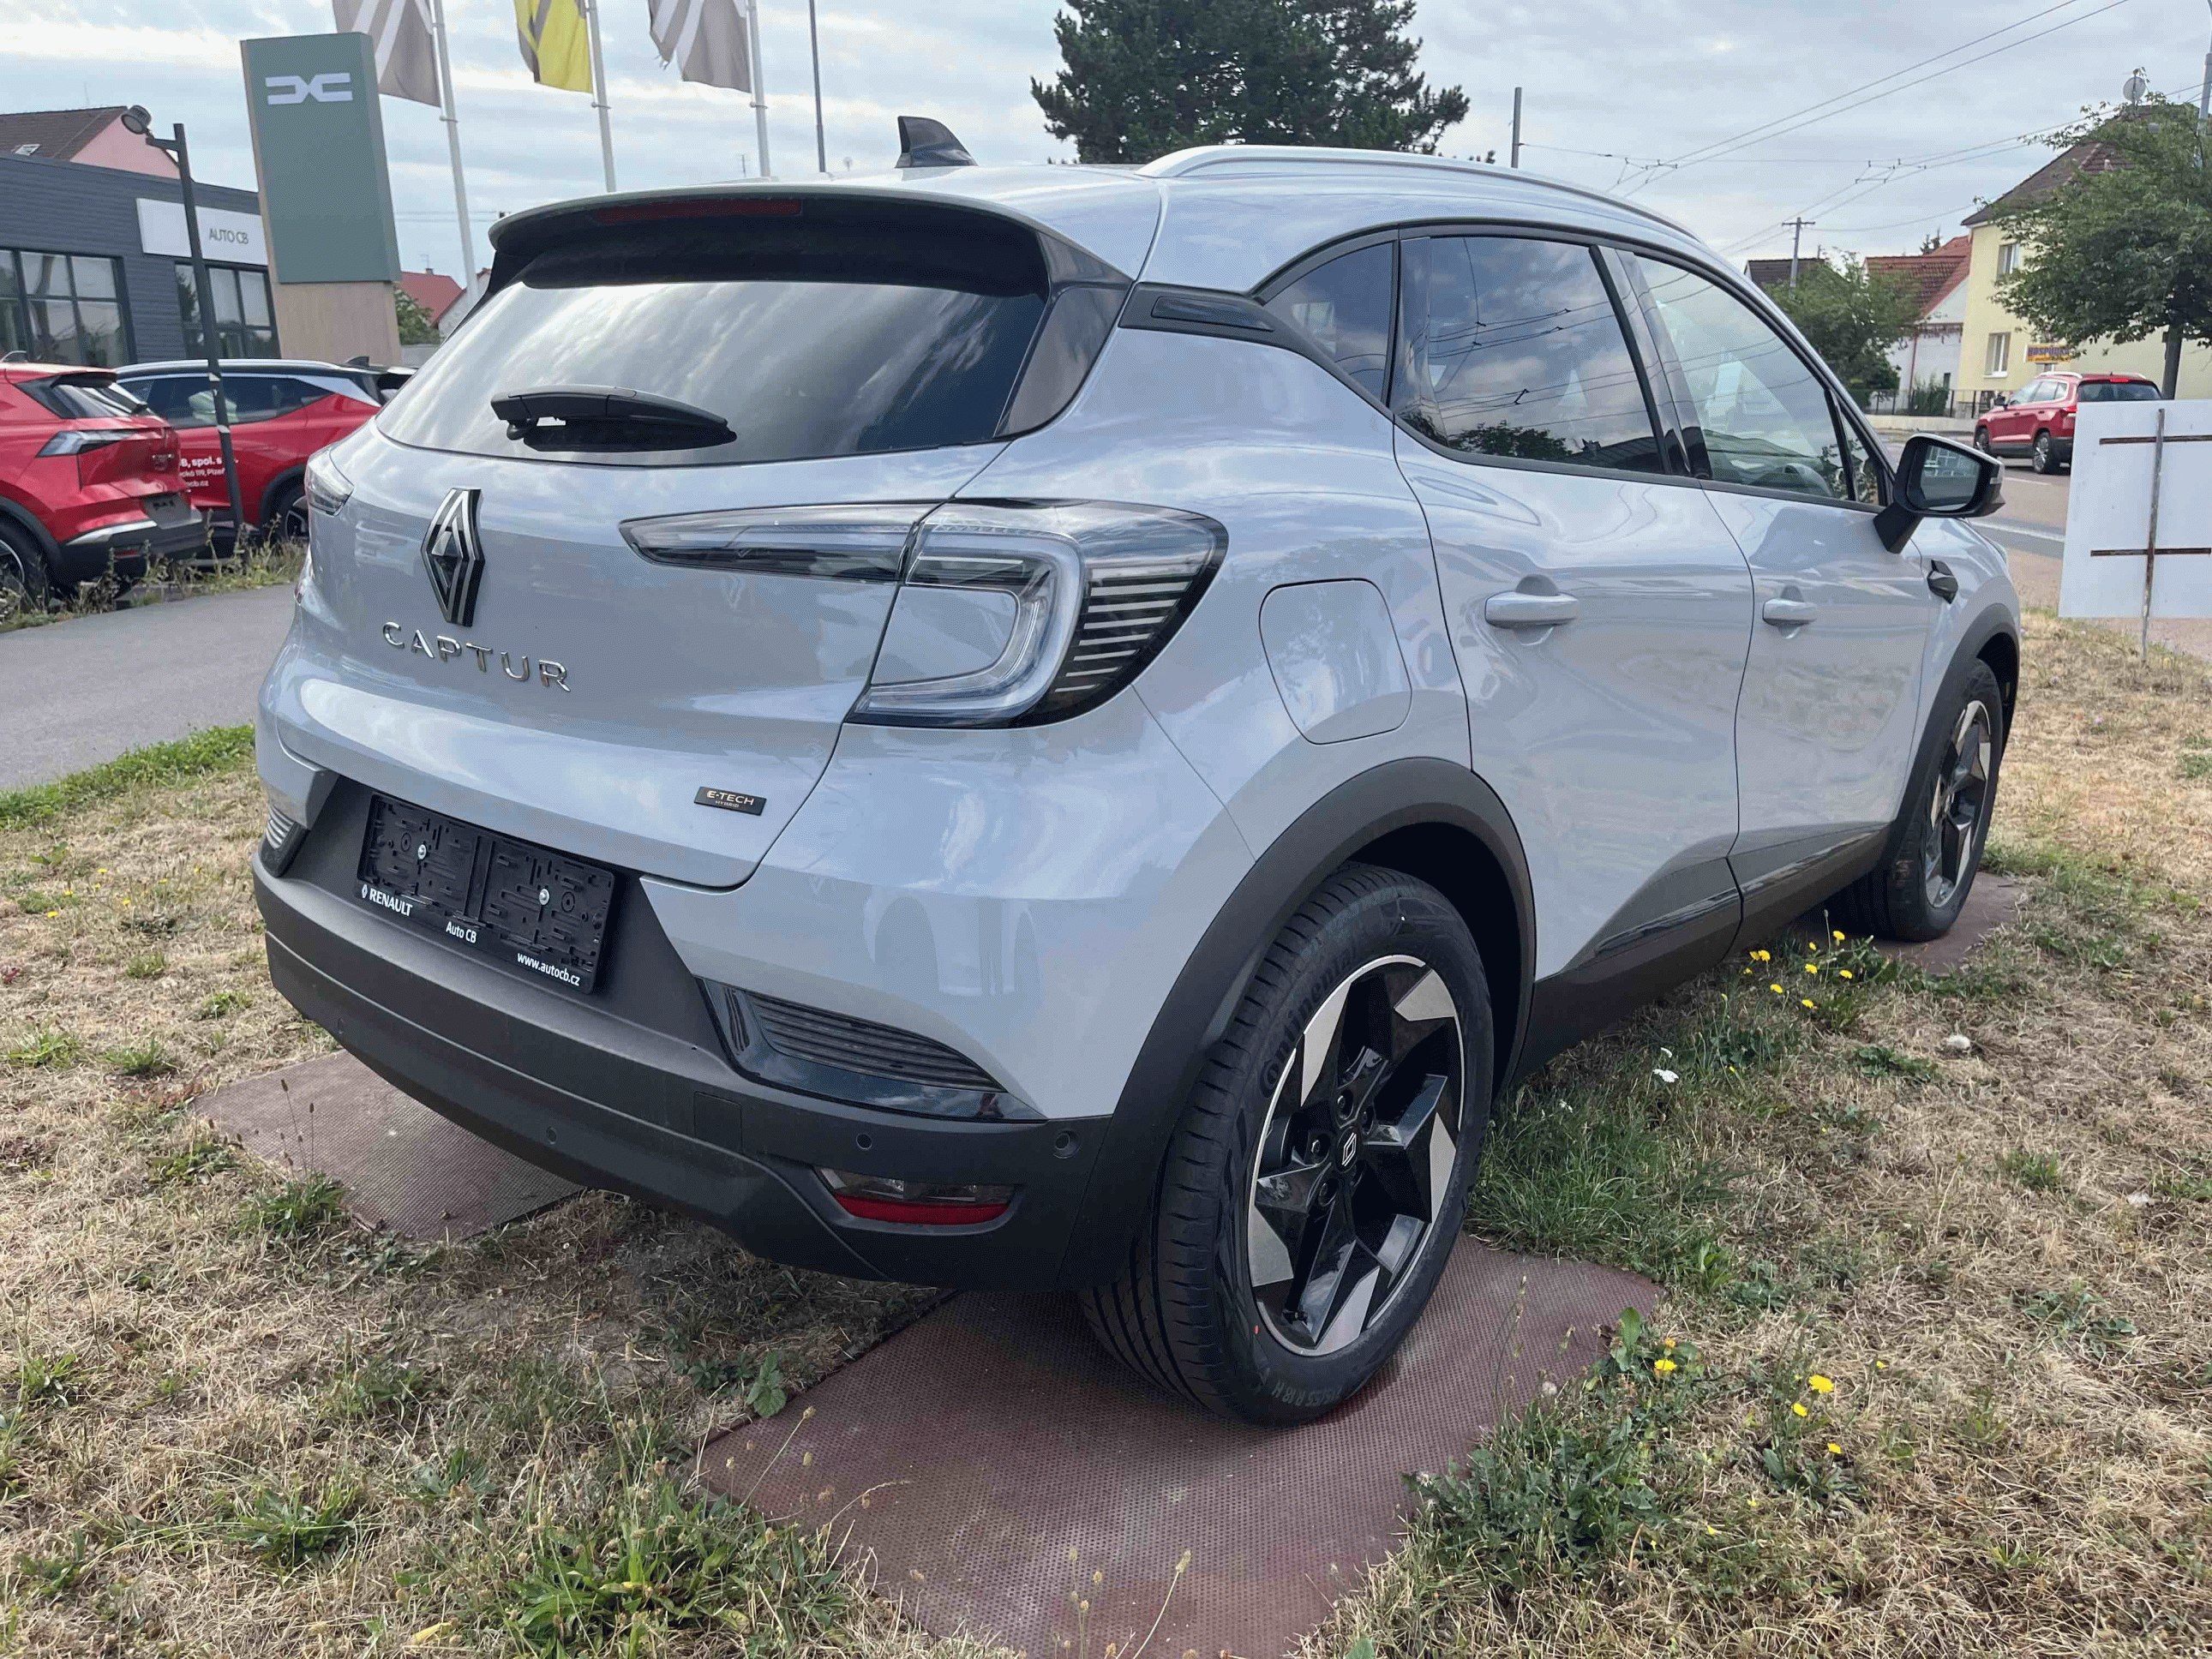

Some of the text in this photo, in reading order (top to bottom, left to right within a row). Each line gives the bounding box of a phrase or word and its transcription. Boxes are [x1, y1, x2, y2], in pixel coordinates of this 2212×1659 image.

[209, 228, 249, 244] AUTO CB
[383, 621, 571, 692] CAPTUR
[706, 790, 755, 806] E-TECH
[369, 888, 413, 917] RENAULT
[446, 921, 477, 943] Auto CB
[517, 953, 581, 986] www.autocb.cz
